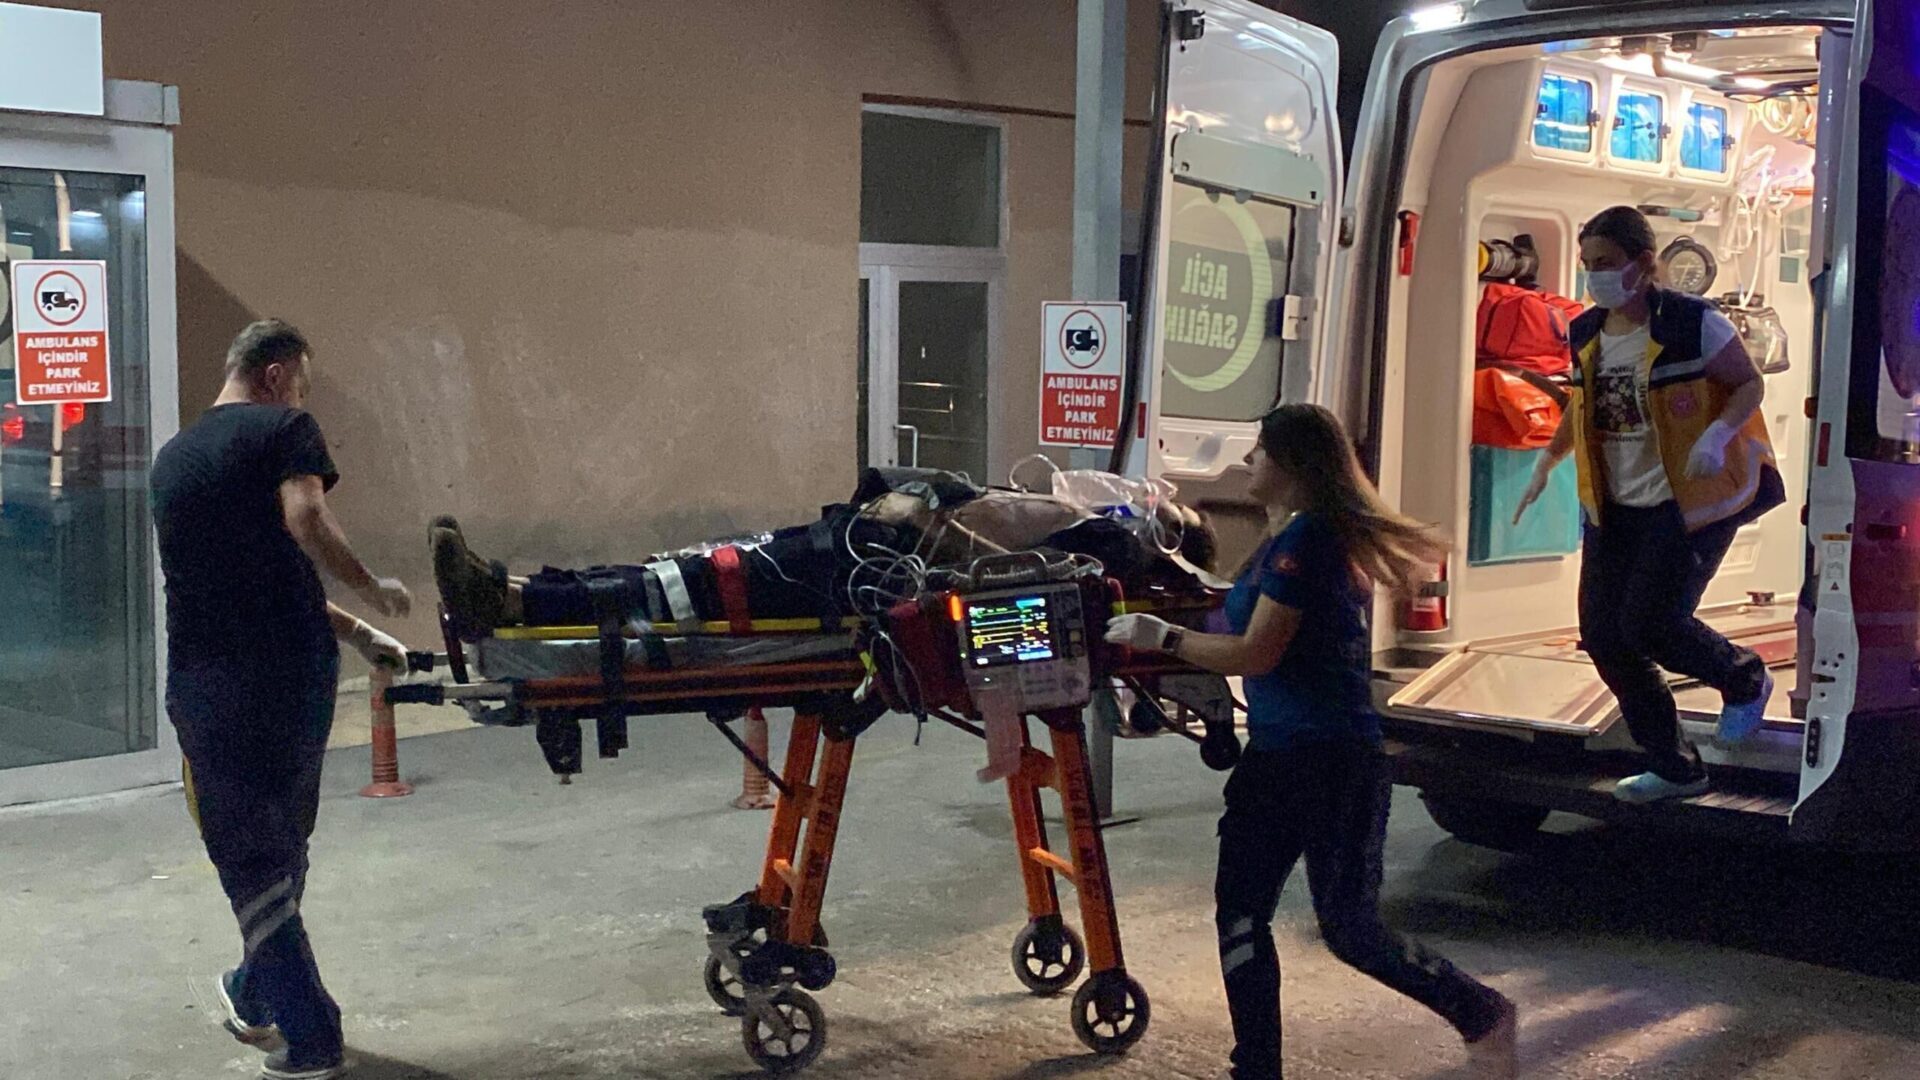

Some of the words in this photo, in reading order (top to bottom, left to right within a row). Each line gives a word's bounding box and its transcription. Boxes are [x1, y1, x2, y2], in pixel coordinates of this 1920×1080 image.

[26, 336, 98, 349] AMBULANS
[38, 350, 88, 365] İÇİNDİR
[46, 367, 81, 378] PARK
[28, 381, 100, 396] ETMEYİNİZ
[1047, 377, 1117, 391] AMBULANS
[1058, 391, 1106, 408] İÇİNDİR
[1065, 411, 1097, 423] PARK
[1046, 424, 1115, 442] ETMEYİNİZ
